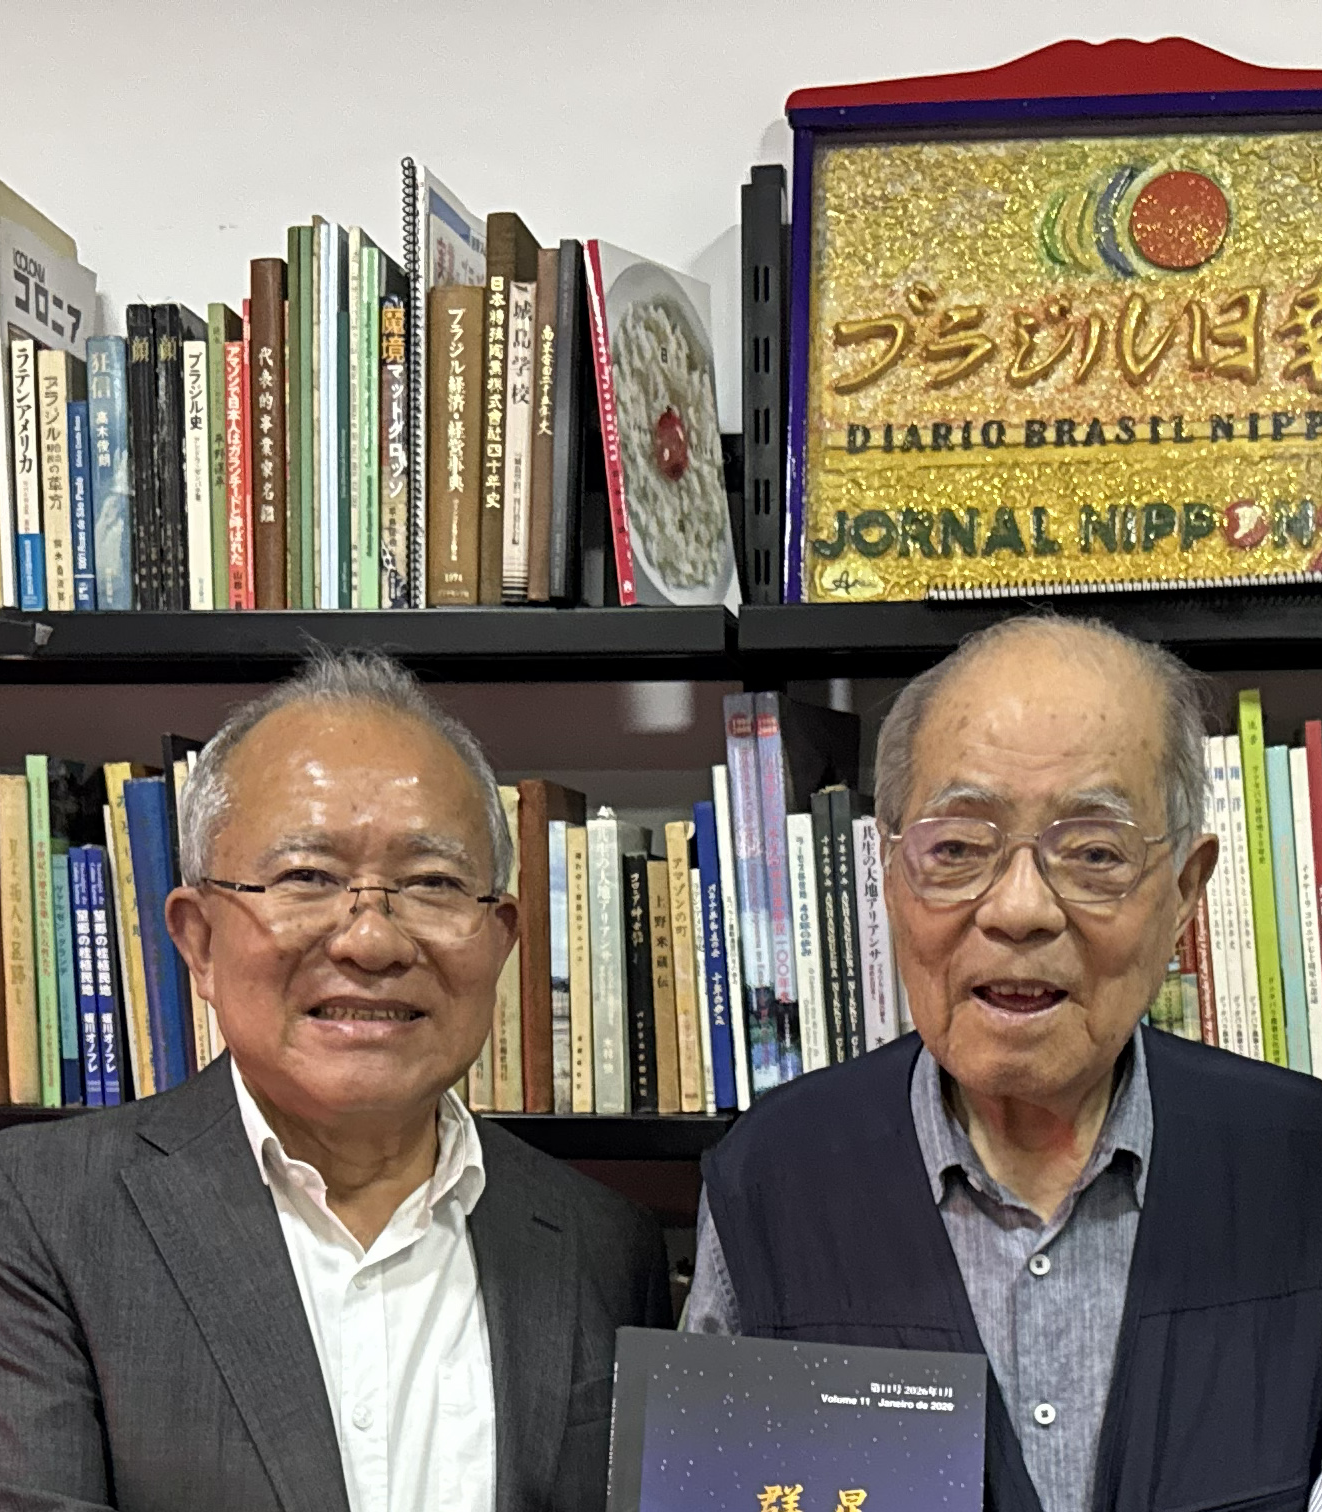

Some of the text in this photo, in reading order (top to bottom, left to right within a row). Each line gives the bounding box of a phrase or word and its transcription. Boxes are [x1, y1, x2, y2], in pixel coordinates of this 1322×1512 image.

[13, 268, 82, 343] コロニア
[15, 347, 33, 475] ラテンアメリカ
[188, 351, 204, 430] ブラジル史
[385, 364, 408, 499] マットグロッソ
[846, 418, 1004, 455] DIARIO
[1024, 413, 1192, 448] BRASIL
[813, 498, 1317, 559] JORNAL NIPPON
[673, 857, 688, 938] アマゾンの町
[821, 1393, 858, 1406] Volume
[859, 1397, 870, 1407] 11
[878, 1398, 915, 1410] Janeiro
[915, 1400, 929, 1411] de
